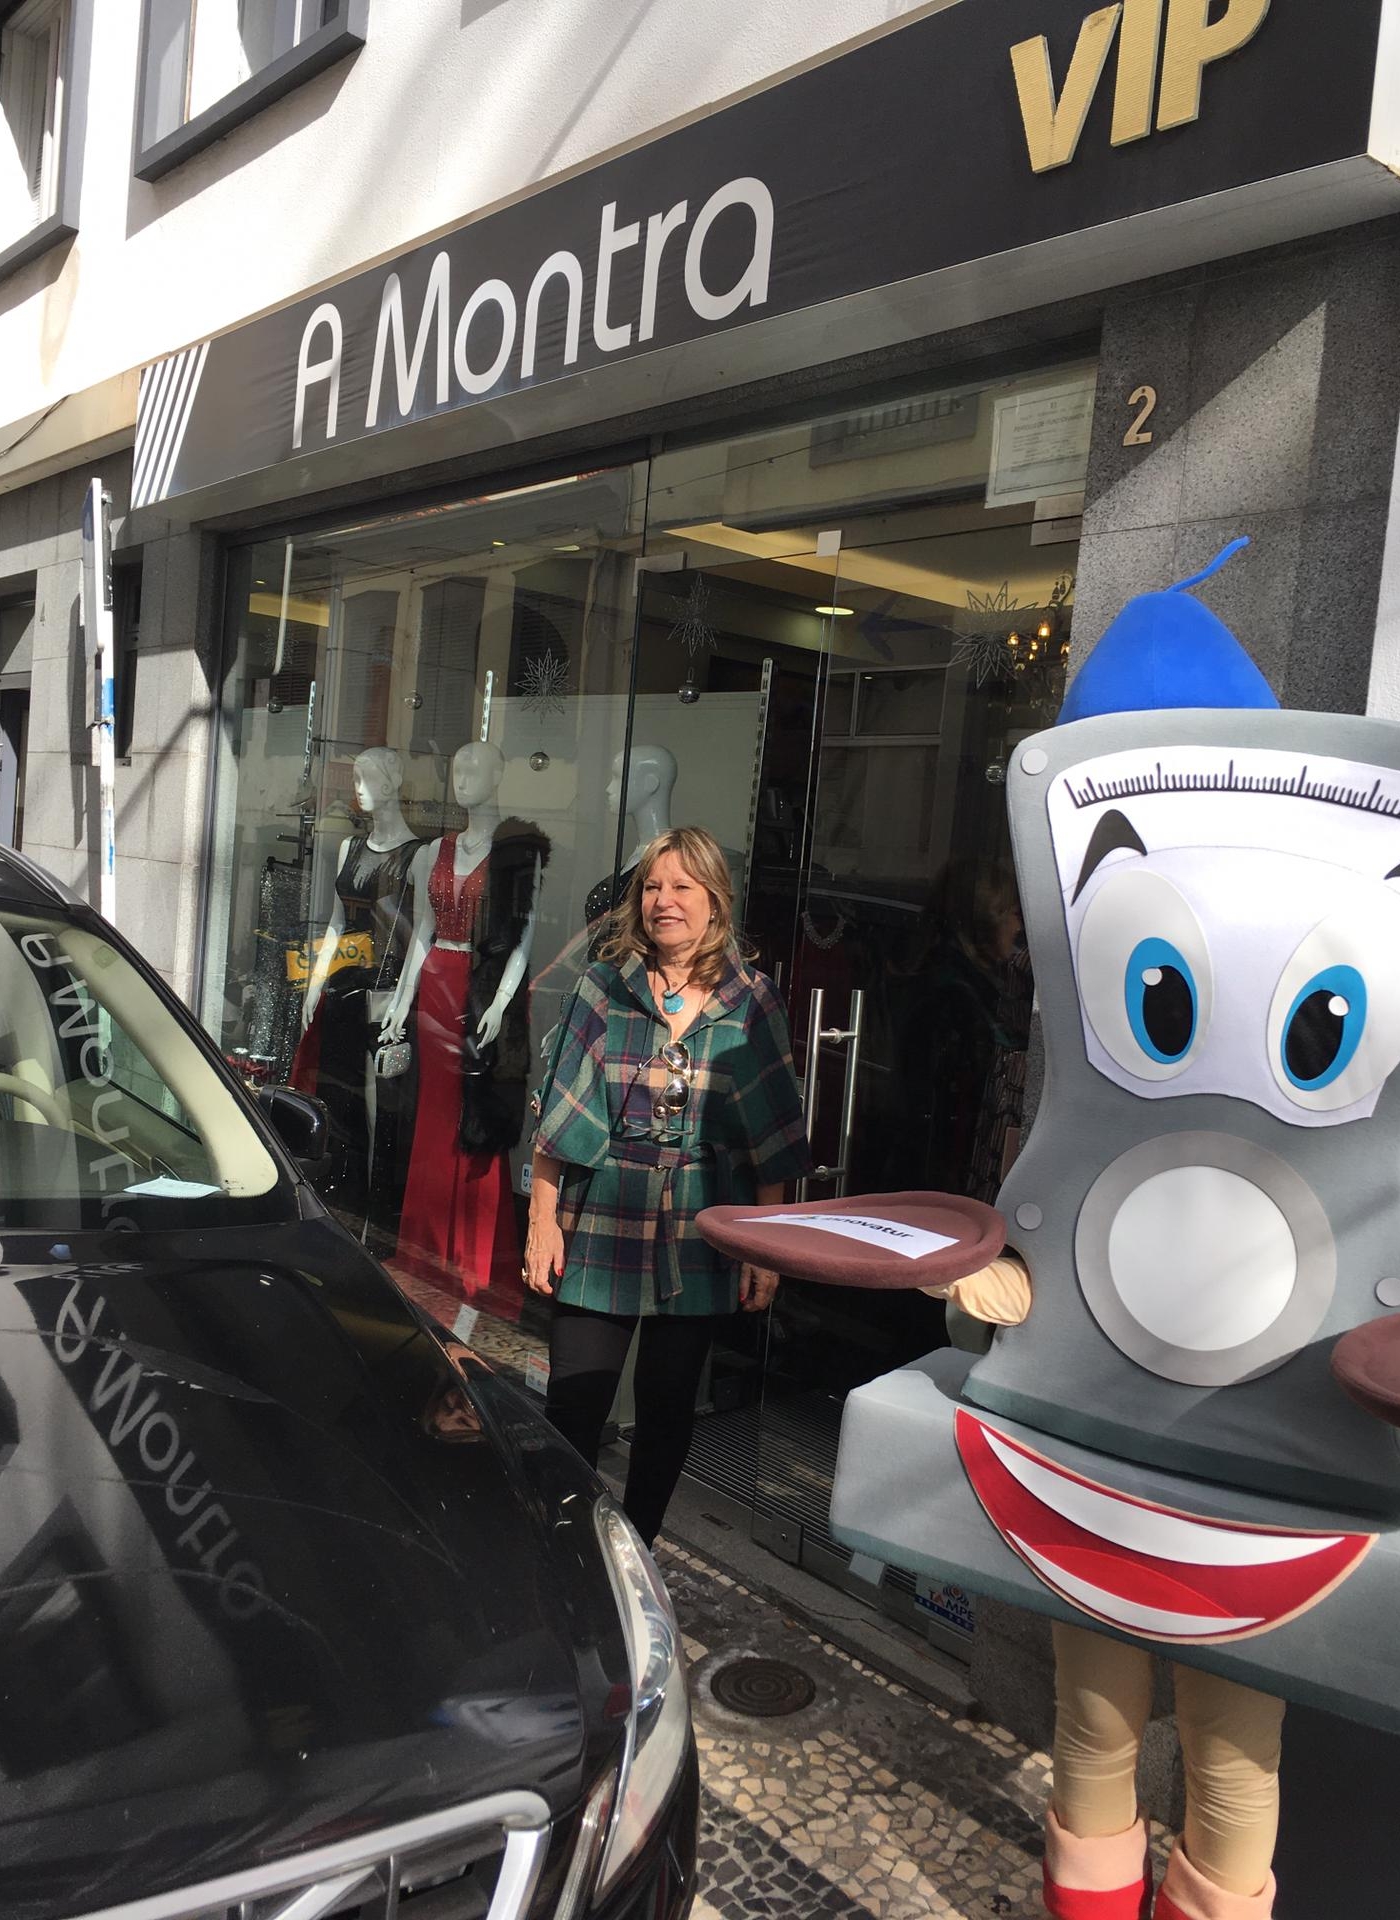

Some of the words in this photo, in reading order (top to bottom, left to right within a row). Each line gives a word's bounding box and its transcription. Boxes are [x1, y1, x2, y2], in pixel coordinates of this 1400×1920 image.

[1010, 0, 1270, 174] VIP
[292, 302, 343, 450] A
[364, 176, 775, 429] Montra
[1123, 385, 1157, 446] 2
